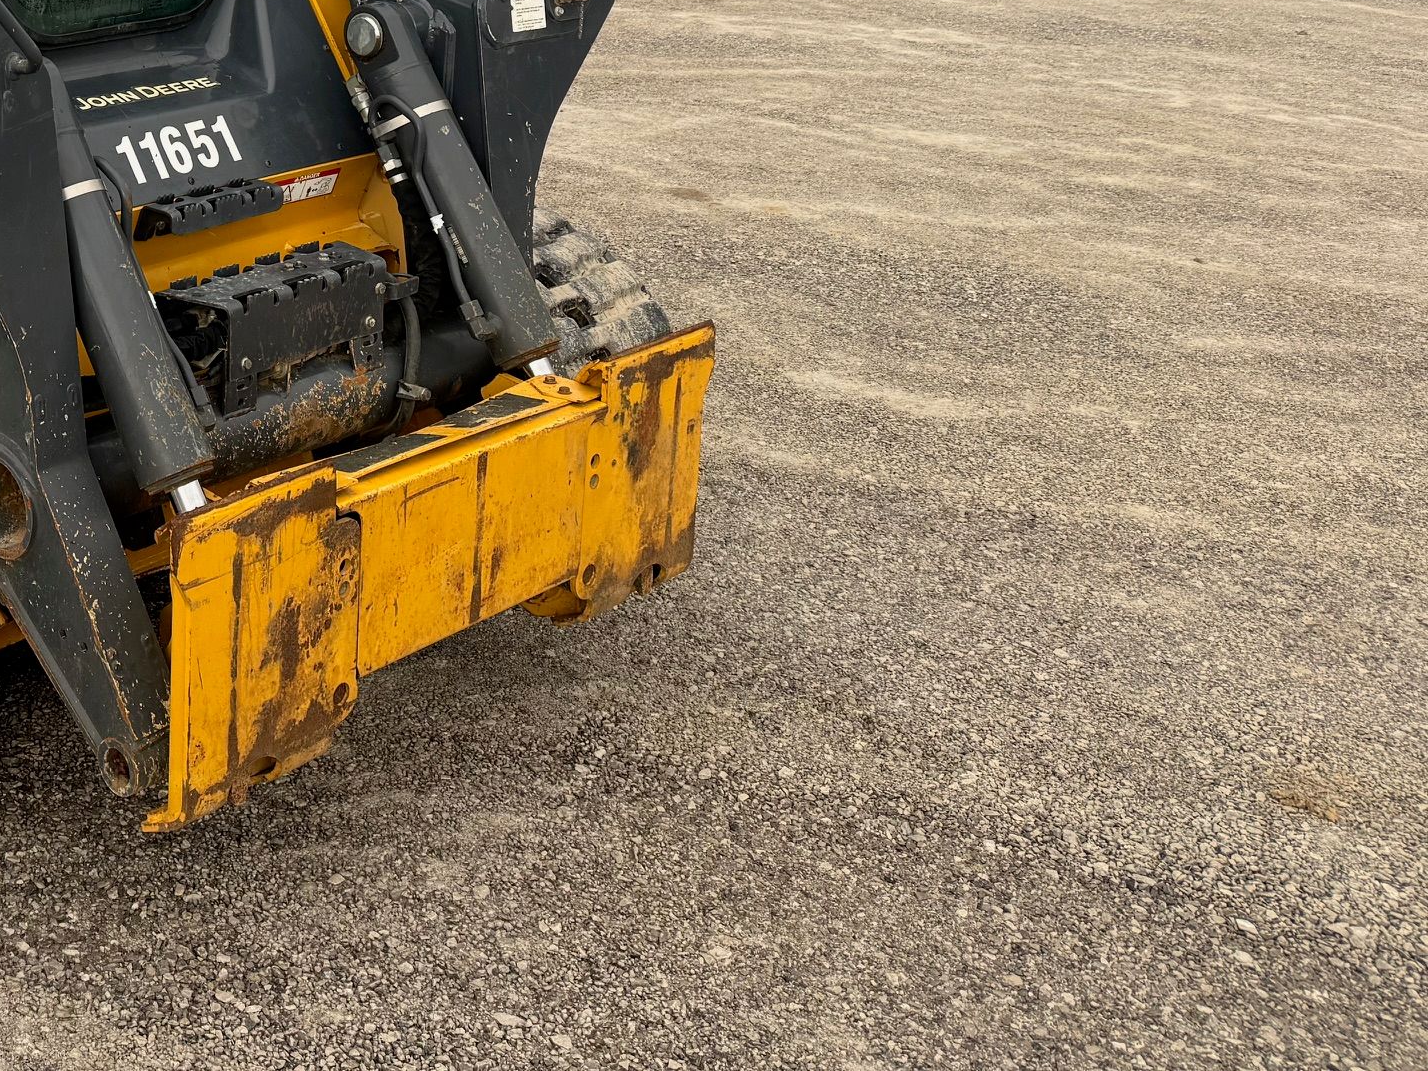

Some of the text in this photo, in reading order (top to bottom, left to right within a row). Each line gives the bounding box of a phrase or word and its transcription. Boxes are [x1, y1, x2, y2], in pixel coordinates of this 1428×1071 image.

[75, 77, 217, 111] JOHN DEERE
[115, 115, 243, 185] 11651
